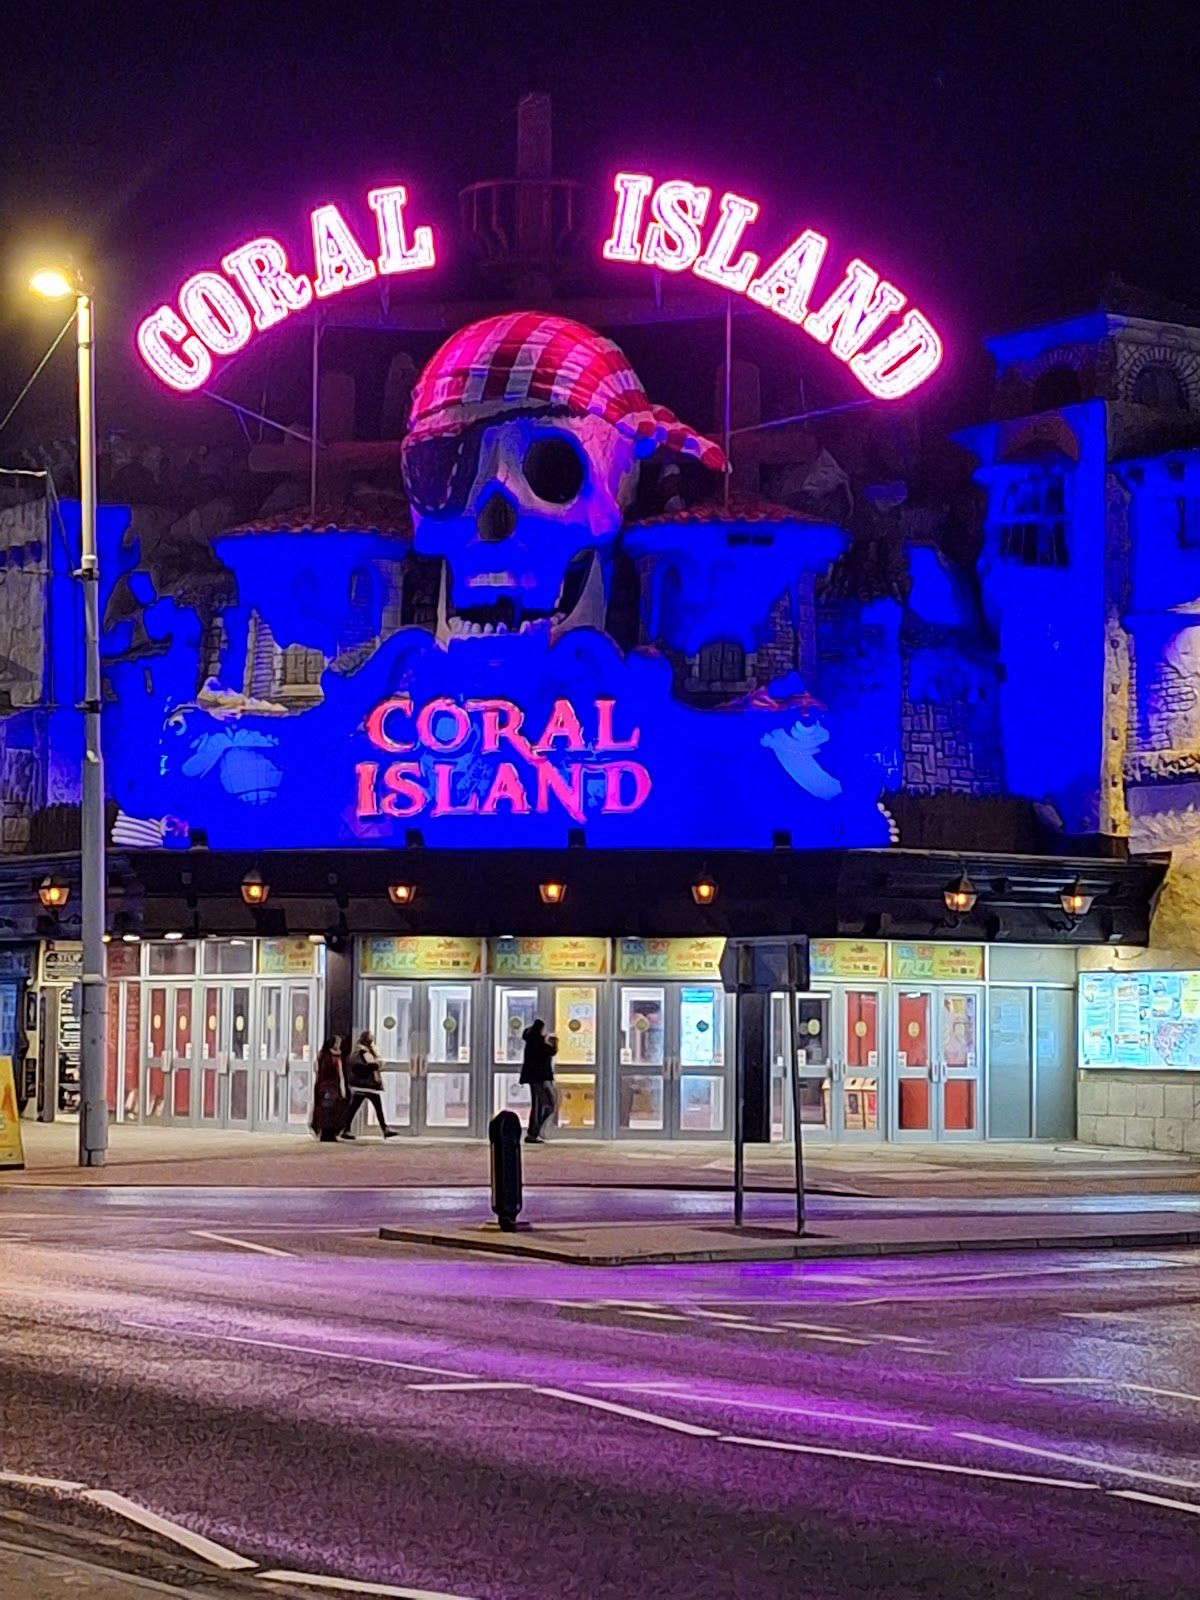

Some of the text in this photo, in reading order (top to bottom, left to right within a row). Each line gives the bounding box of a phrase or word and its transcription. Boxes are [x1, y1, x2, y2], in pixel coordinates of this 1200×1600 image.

[138, 173, 943, 400] CORAL ISLAND
[366, 697, 641, 762] CORAL
[356, 760, 653, 824] ISLAND
